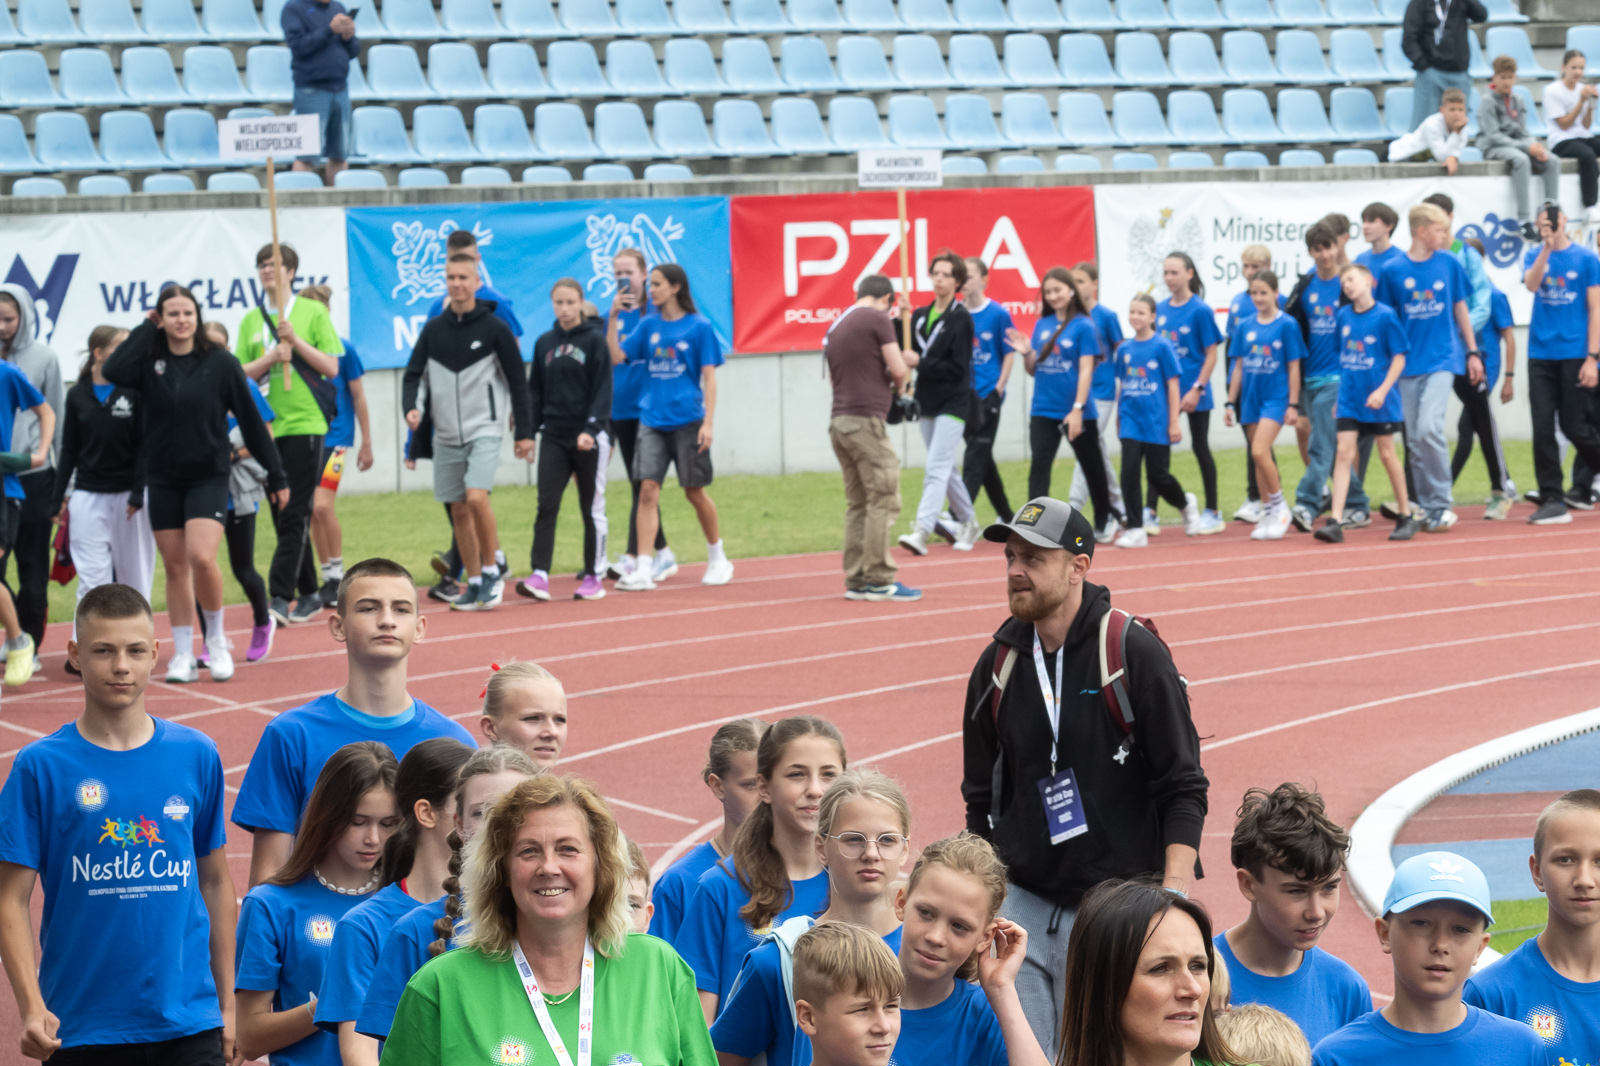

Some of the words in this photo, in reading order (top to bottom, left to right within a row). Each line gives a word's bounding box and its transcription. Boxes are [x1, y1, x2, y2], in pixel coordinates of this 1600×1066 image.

[1213, 216, 1361, 243] Ministero
[783, 216, 1041, 297] PZLA
[72, 853, 144, 883] Nestlé
[149, 849, 191, 887] Cup
